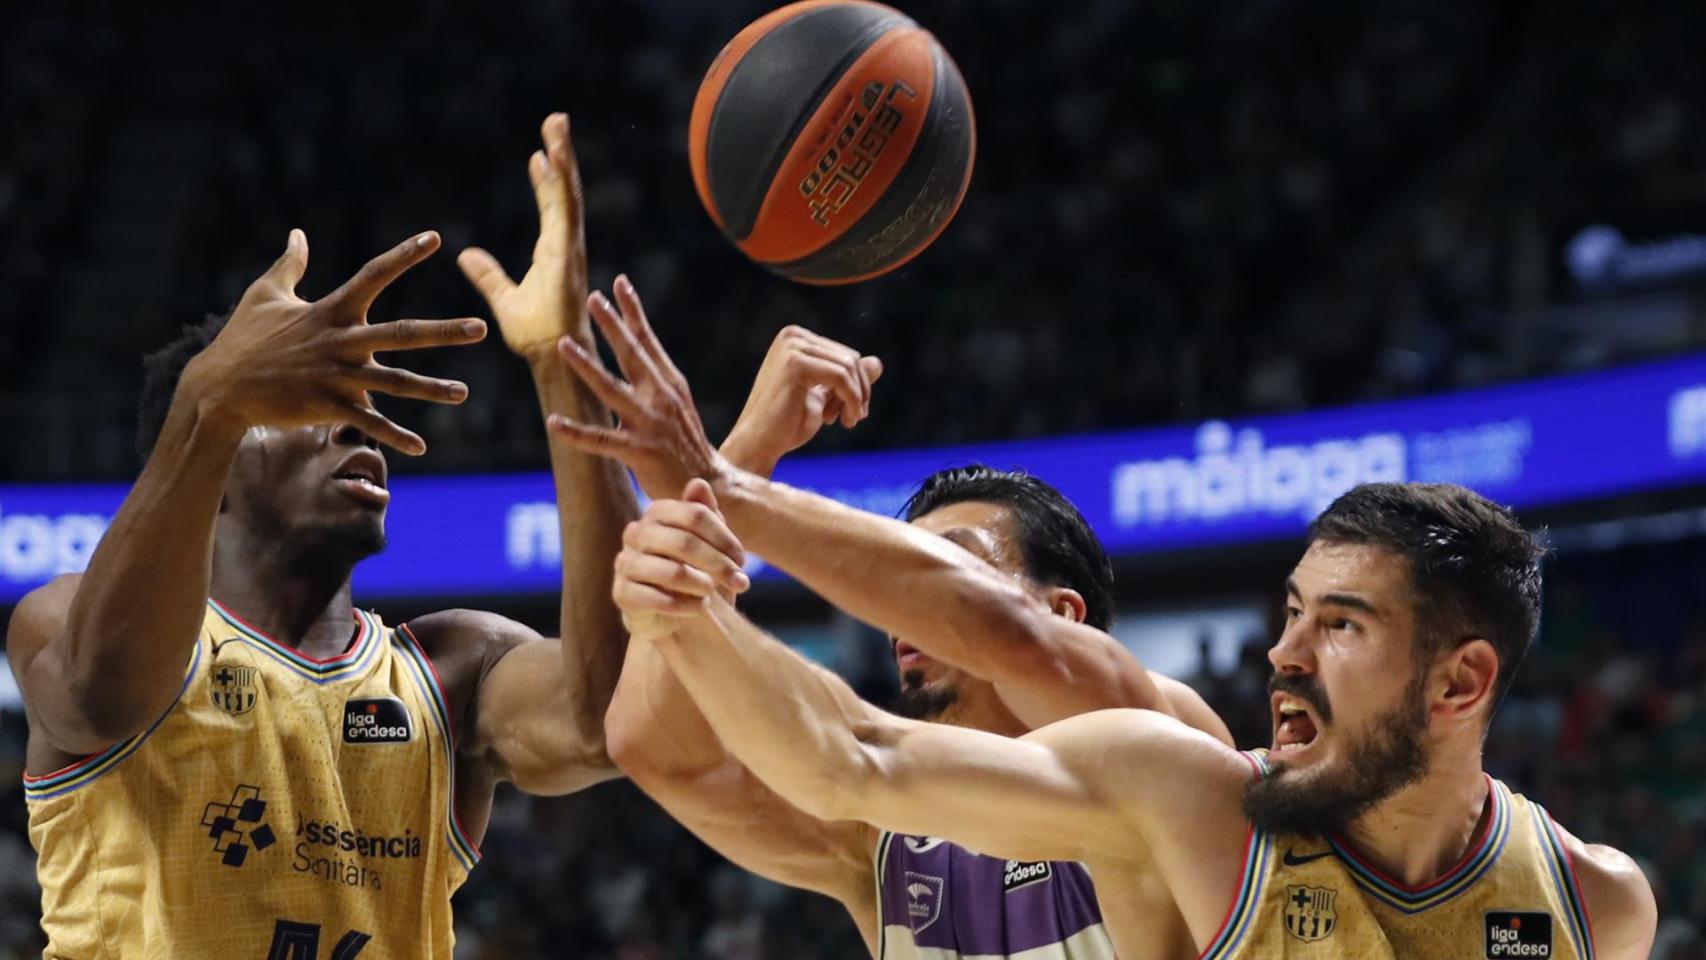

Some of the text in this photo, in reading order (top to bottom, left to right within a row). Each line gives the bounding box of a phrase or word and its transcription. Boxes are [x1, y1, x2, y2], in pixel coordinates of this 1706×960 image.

[809, 79, 916, 228] LEGACY
[348, 711, 375, 727] liga
[348, 724, 407, 738] endesa
[1004, 862, 1046, 886] endesa
[1491, 925, 1518, 943] liga
[1491, 940, 1549, 956] endesa
